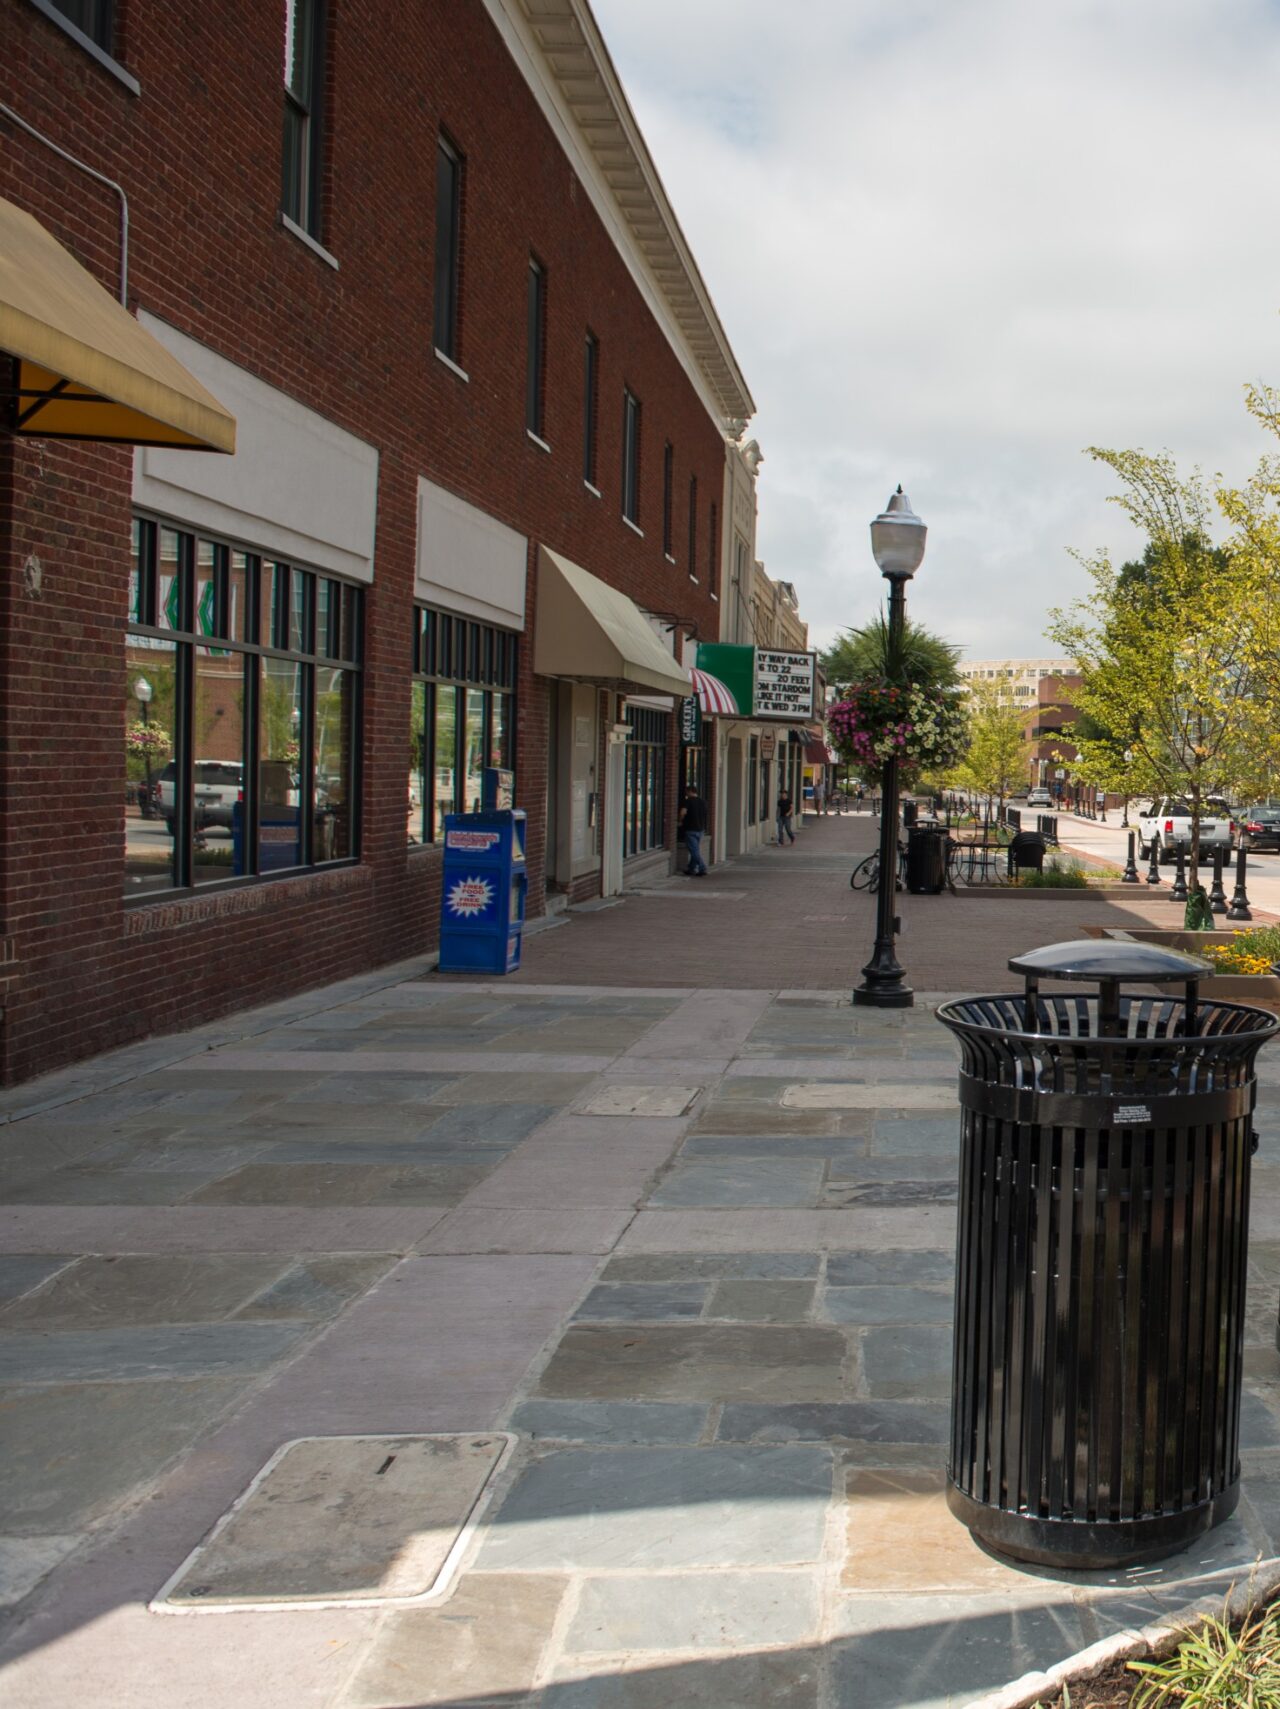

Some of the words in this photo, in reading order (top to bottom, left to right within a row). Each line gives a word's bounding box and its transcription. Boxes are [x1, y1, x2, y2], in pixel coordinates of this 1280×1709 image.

[768, 655, 786, 664] WAY
[788, 657, 809, 666] BACK
[767, 664, 779, 673] TO
[781, 665, 791, 674] 22
[777, 674, 789, 683] 20
[791, 675, 810, 685] FEET
[772, 684, 811, 694] STARDOM
[775, 693, 782, 702] IT
[784, 694, 799, 703] HOT
[771, 702, 789, 712] WED
